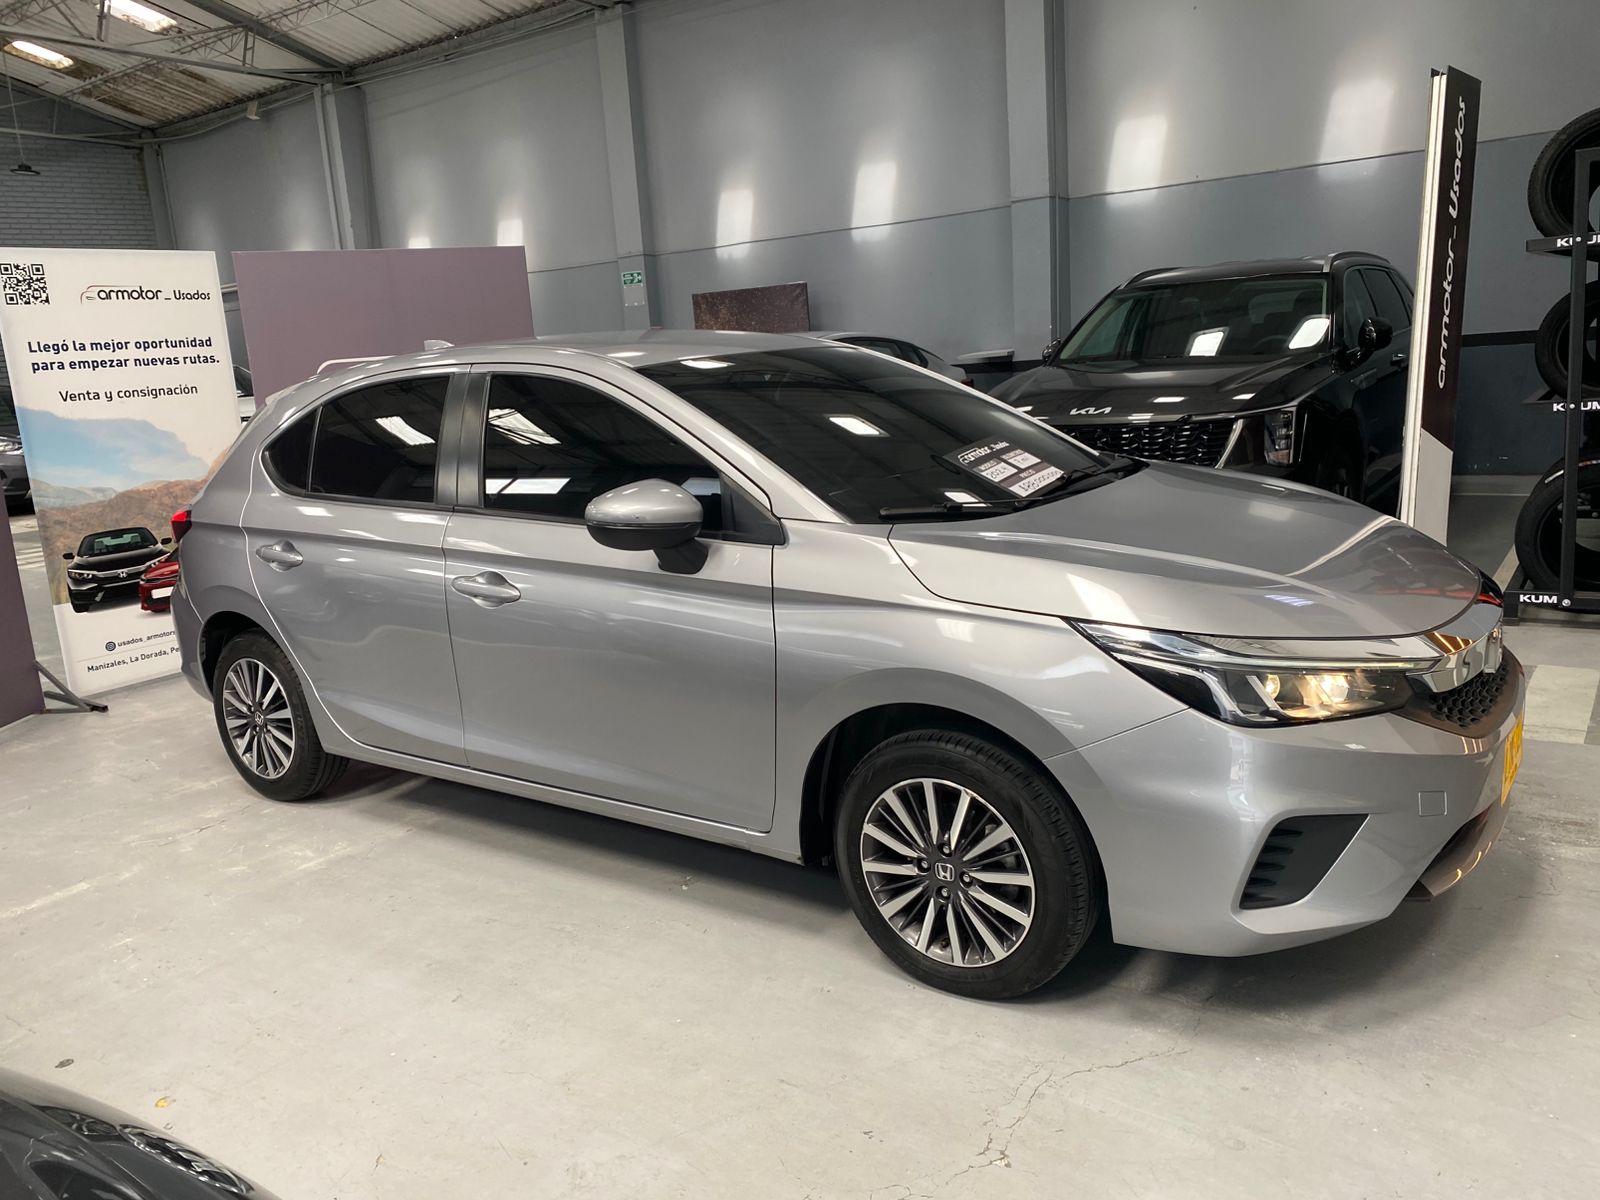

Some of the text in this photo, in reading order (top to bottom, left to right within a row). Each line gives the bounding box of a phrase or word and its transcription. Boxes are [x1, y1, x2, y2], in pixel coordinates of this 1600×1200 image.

[28, 336, 213, 355] Llegó la mejor oportunidad
[31, 353, 220, 374] para empezar nuevas rutas.
[59, 384, 198, 403] Venta y consignación
[87, 657, 129, 673] Manizales,
[130, 655, 139, 664] La
[140, 648, 170, 662] Dorada,
